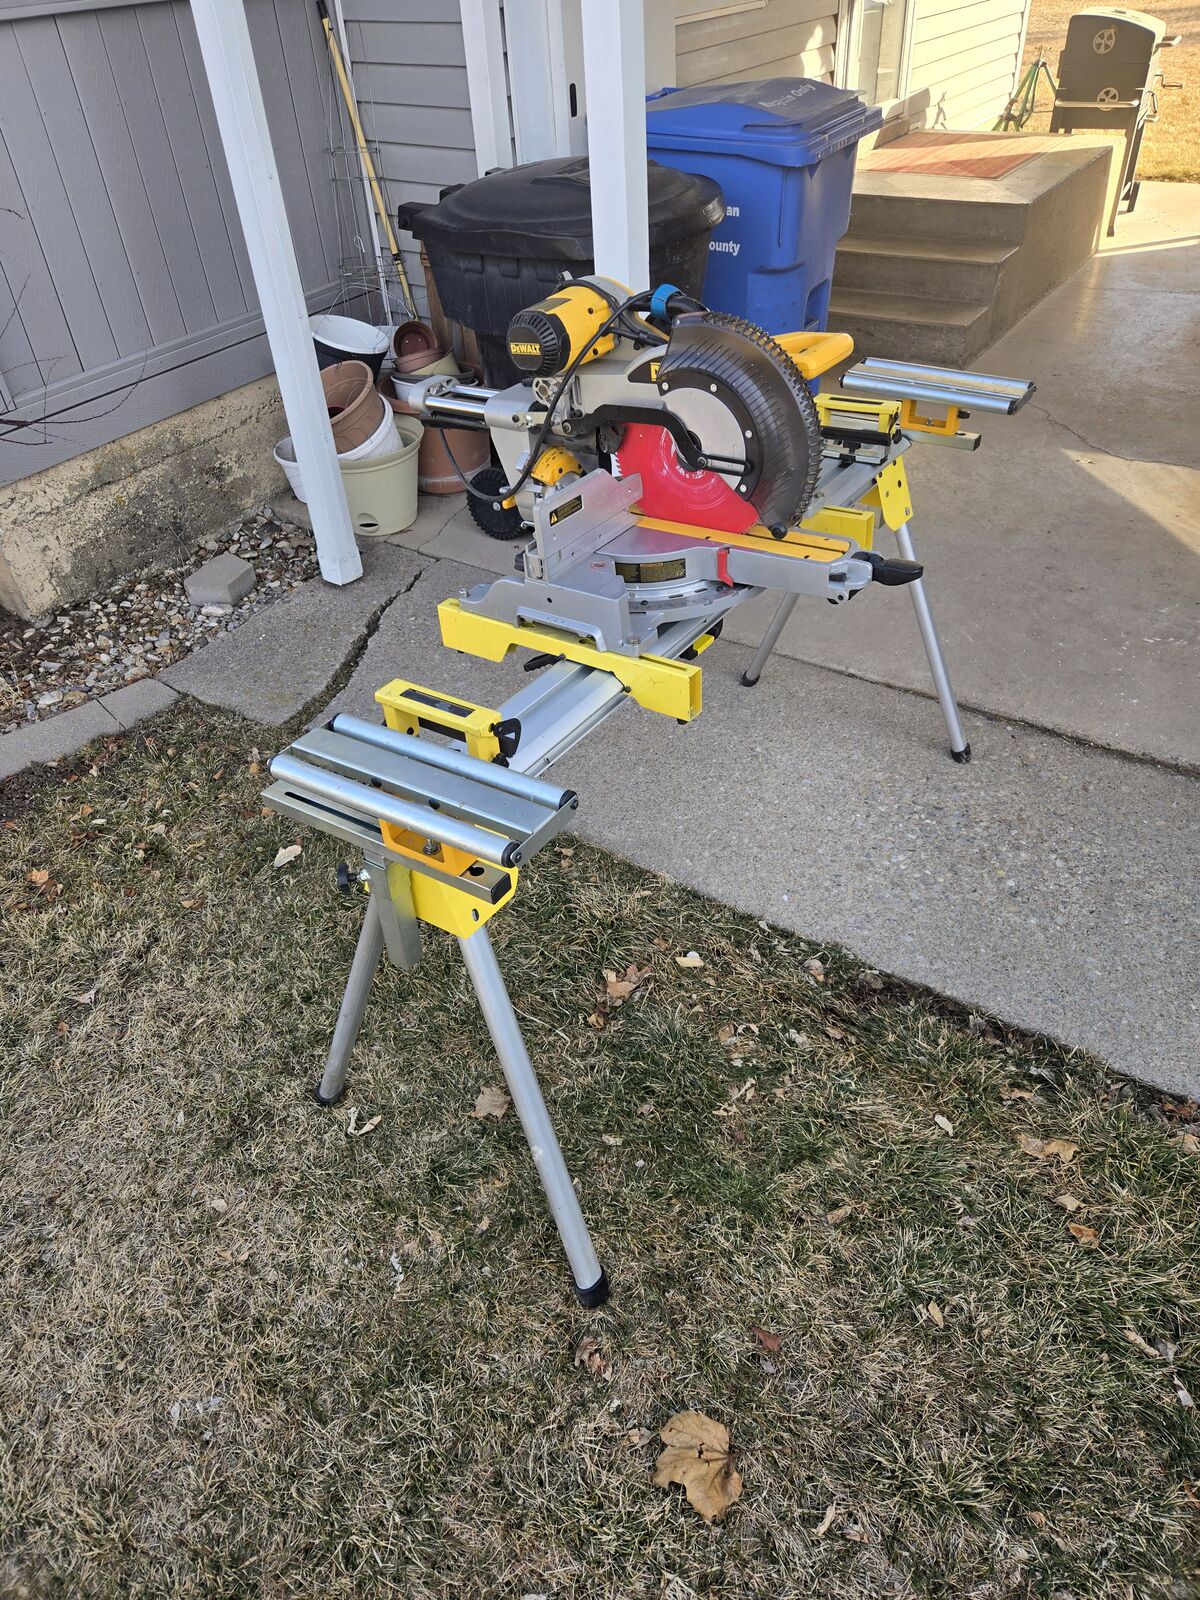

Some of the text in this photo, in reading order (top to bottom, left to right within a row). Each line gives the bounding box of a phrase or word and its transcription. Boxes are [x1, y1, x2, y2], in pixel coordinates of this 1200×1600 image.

[790, 83, 816, 97] Only
[708, 240, 741, 256] ounty
[510, 343, 541, 354] DEWALT
